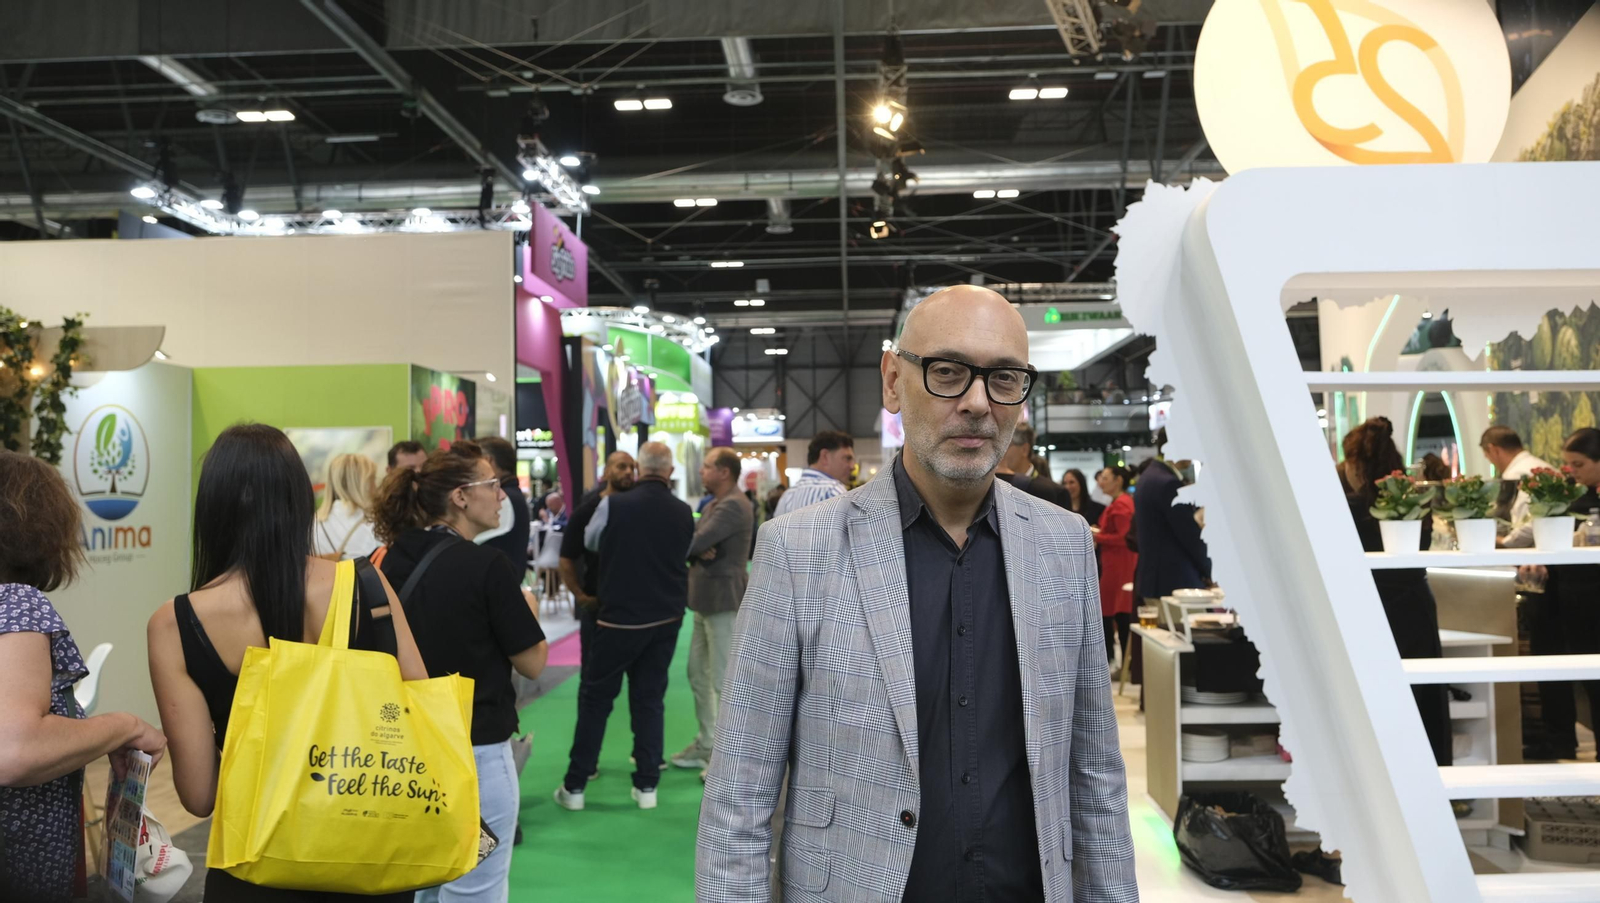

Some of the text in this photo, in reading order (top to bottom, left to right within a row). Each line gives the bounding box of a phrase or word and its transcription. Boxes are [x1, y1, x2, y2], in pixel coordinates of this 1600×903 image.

[375, 725, 401, 733] citrinos
[379, 732, 404, 740] algarve
[309, 744, 427, 774] Get the Taste
[328, 773, 441, 802] Feel the Sun
